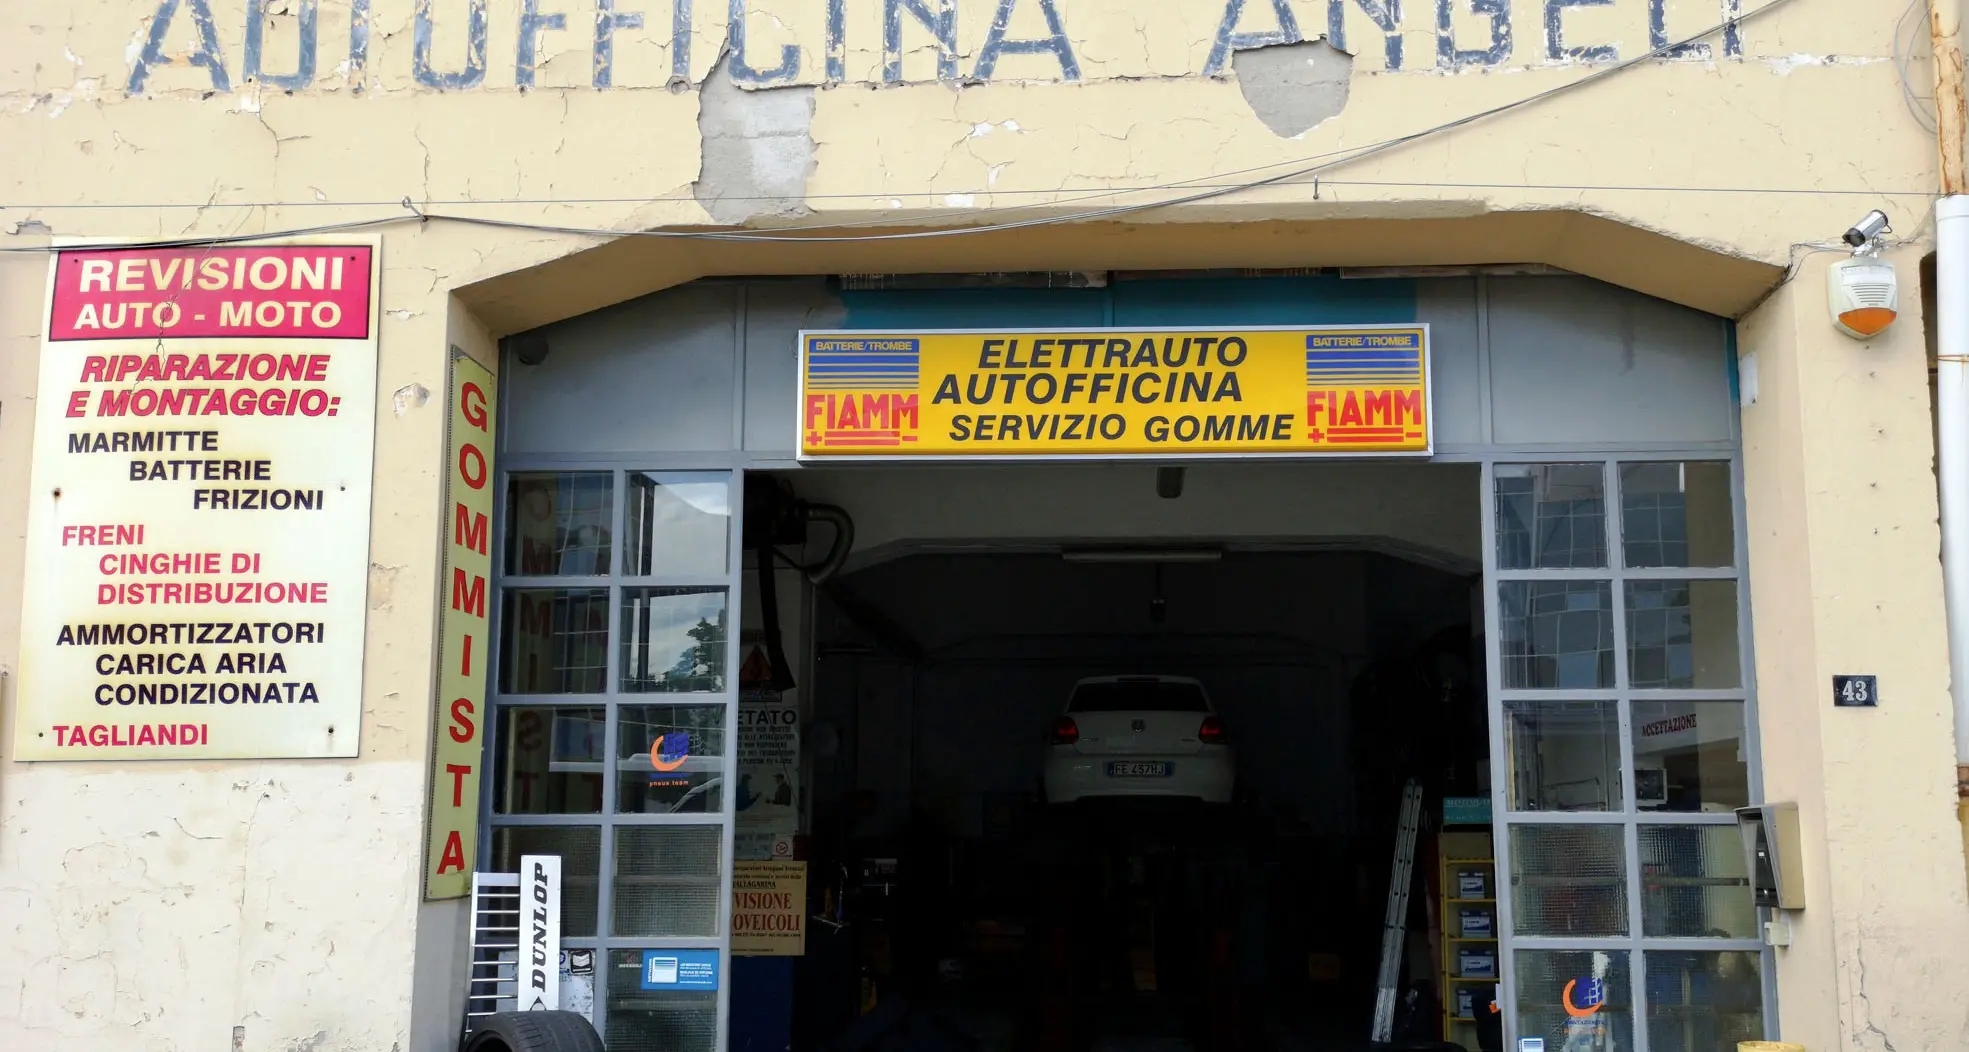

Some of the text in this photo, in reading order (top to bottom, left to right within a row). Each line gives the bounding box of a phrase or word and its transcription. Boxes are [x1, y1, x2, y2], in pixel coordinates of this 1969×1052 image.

[78, 255, 344, 293] REVISIONI
[73, 302, 182, 330] AUTO
[219, 300, 341, 329] MOTO
[815, 341, 913, 351] BATTERIE/TROMBE
[978, 336, 1248, 369] ELETTRAUTO
[1312, 336, 1412, 347] BATTERIE/TROMBE
[80, 354, 331, 383] RIPARAZIONE
[931, 371, 1243, 405] AUTOFFICINA
[65, 389, 341, 418] E MONTAGGIO:
[806, 393, 919, 430] FIAMM
[1306, 389, 1422, 427] FIAMM
[949, 413, 1295, 442] SERVIZIO GOMME
[67, 431, 219, 454] MARMITTE
[129, 460, 272, 482] BATTERIE
[193, 489, 324, 511] FRIZIONI
[61, 524, 145, 547] FRENI
[99, 552, 261, 576] CINGHIE DI
[97, 581, 328, 606] DISTRIBUZIONE
[55, 622, 325, 647] AMMORTIZZATORI
[436, 381, 489, 876] GOMMISTA
[95, 652, 288, 676] CARICA ARIA
[94, 682, 320, 706] CONDIZIONATA
[1842, 680, 1868, 702] 43
[52, 723, 209, 747] TAGLIANDI
[1641, 713, 1698, 738] ACCETTAZIONE
[531, 862, 549, 993] DUNLOP
